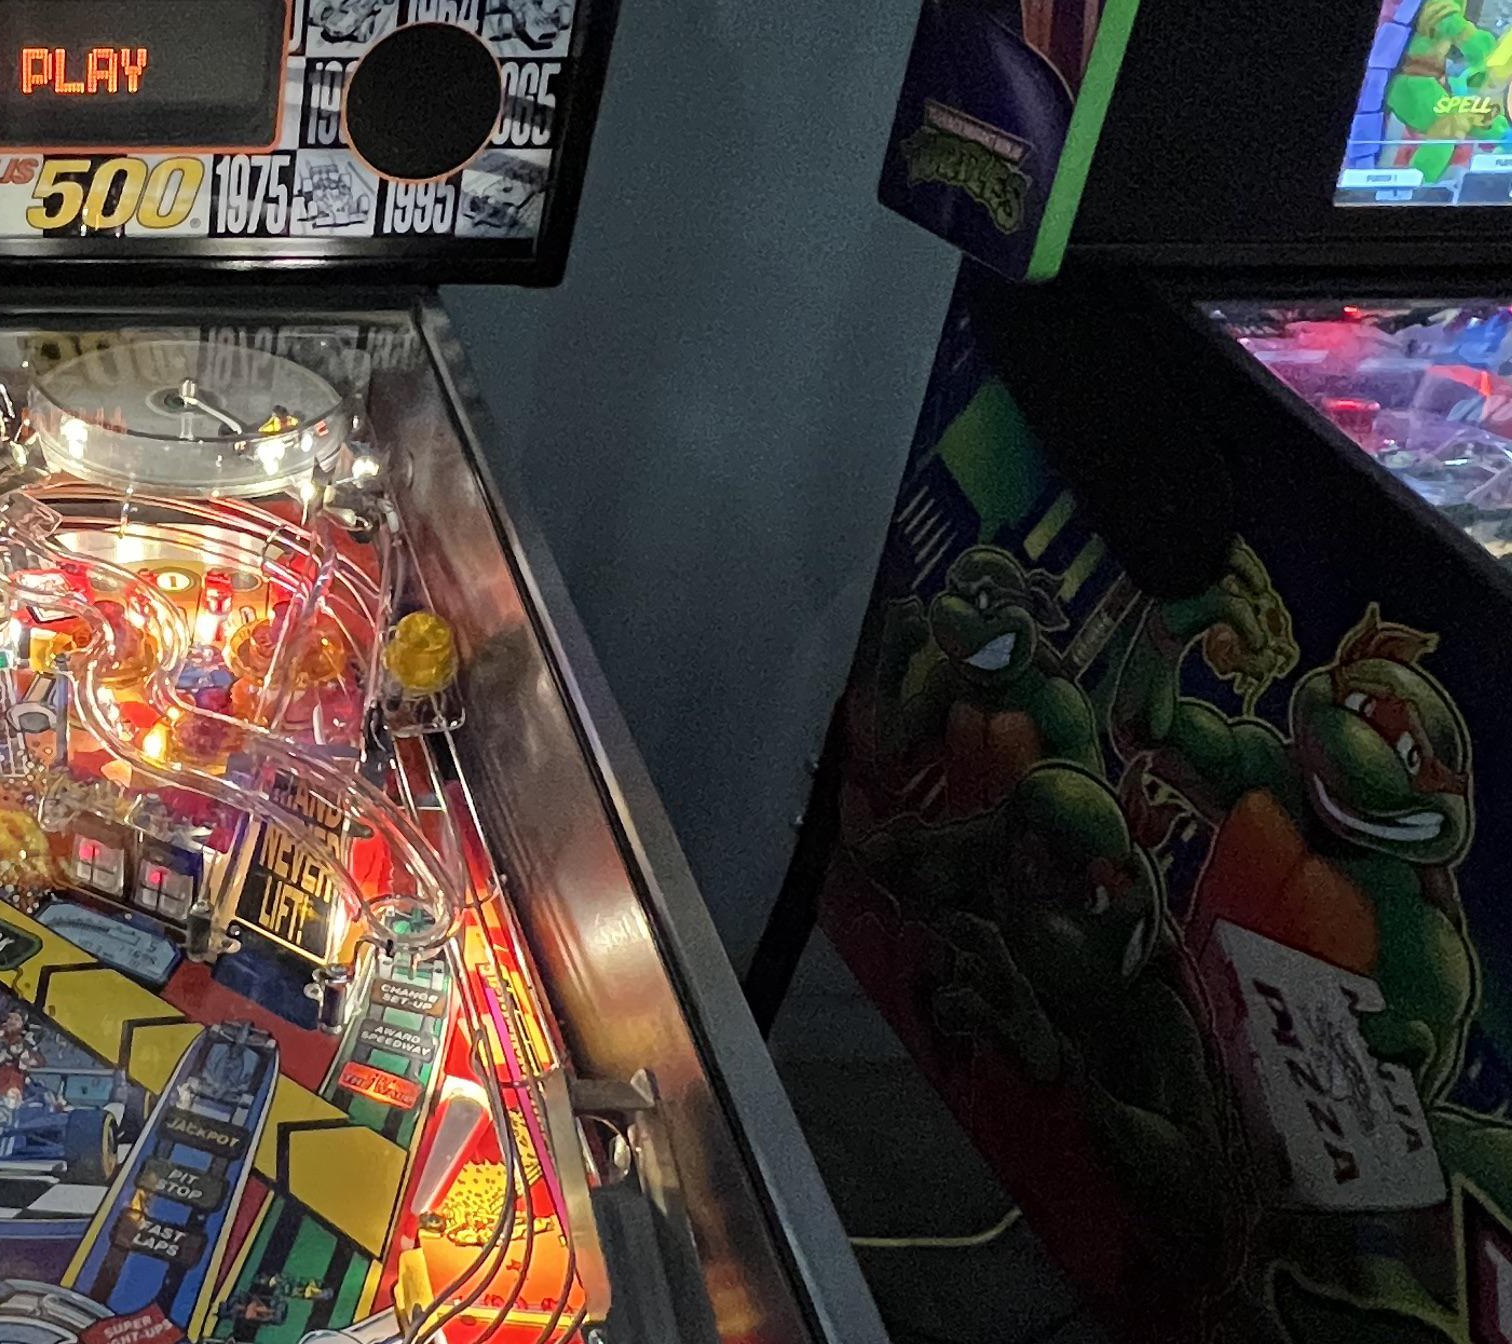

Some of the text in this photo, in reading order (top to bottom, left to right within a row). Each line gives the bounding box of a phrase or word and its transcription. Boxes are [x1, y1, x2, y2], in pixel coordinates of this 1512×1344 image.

[20, 47, 148, 94] PLAY
[1433, 96, 1492, 114] SPELL
[25, 157, 206, 230] 500
[215, 154, 290, 235] 1975
[374, 1026, 421, 1044] AWARD
[131, 1231, 181, 1258] LAPS
[103, 1312, 154, 1339] SUPER
